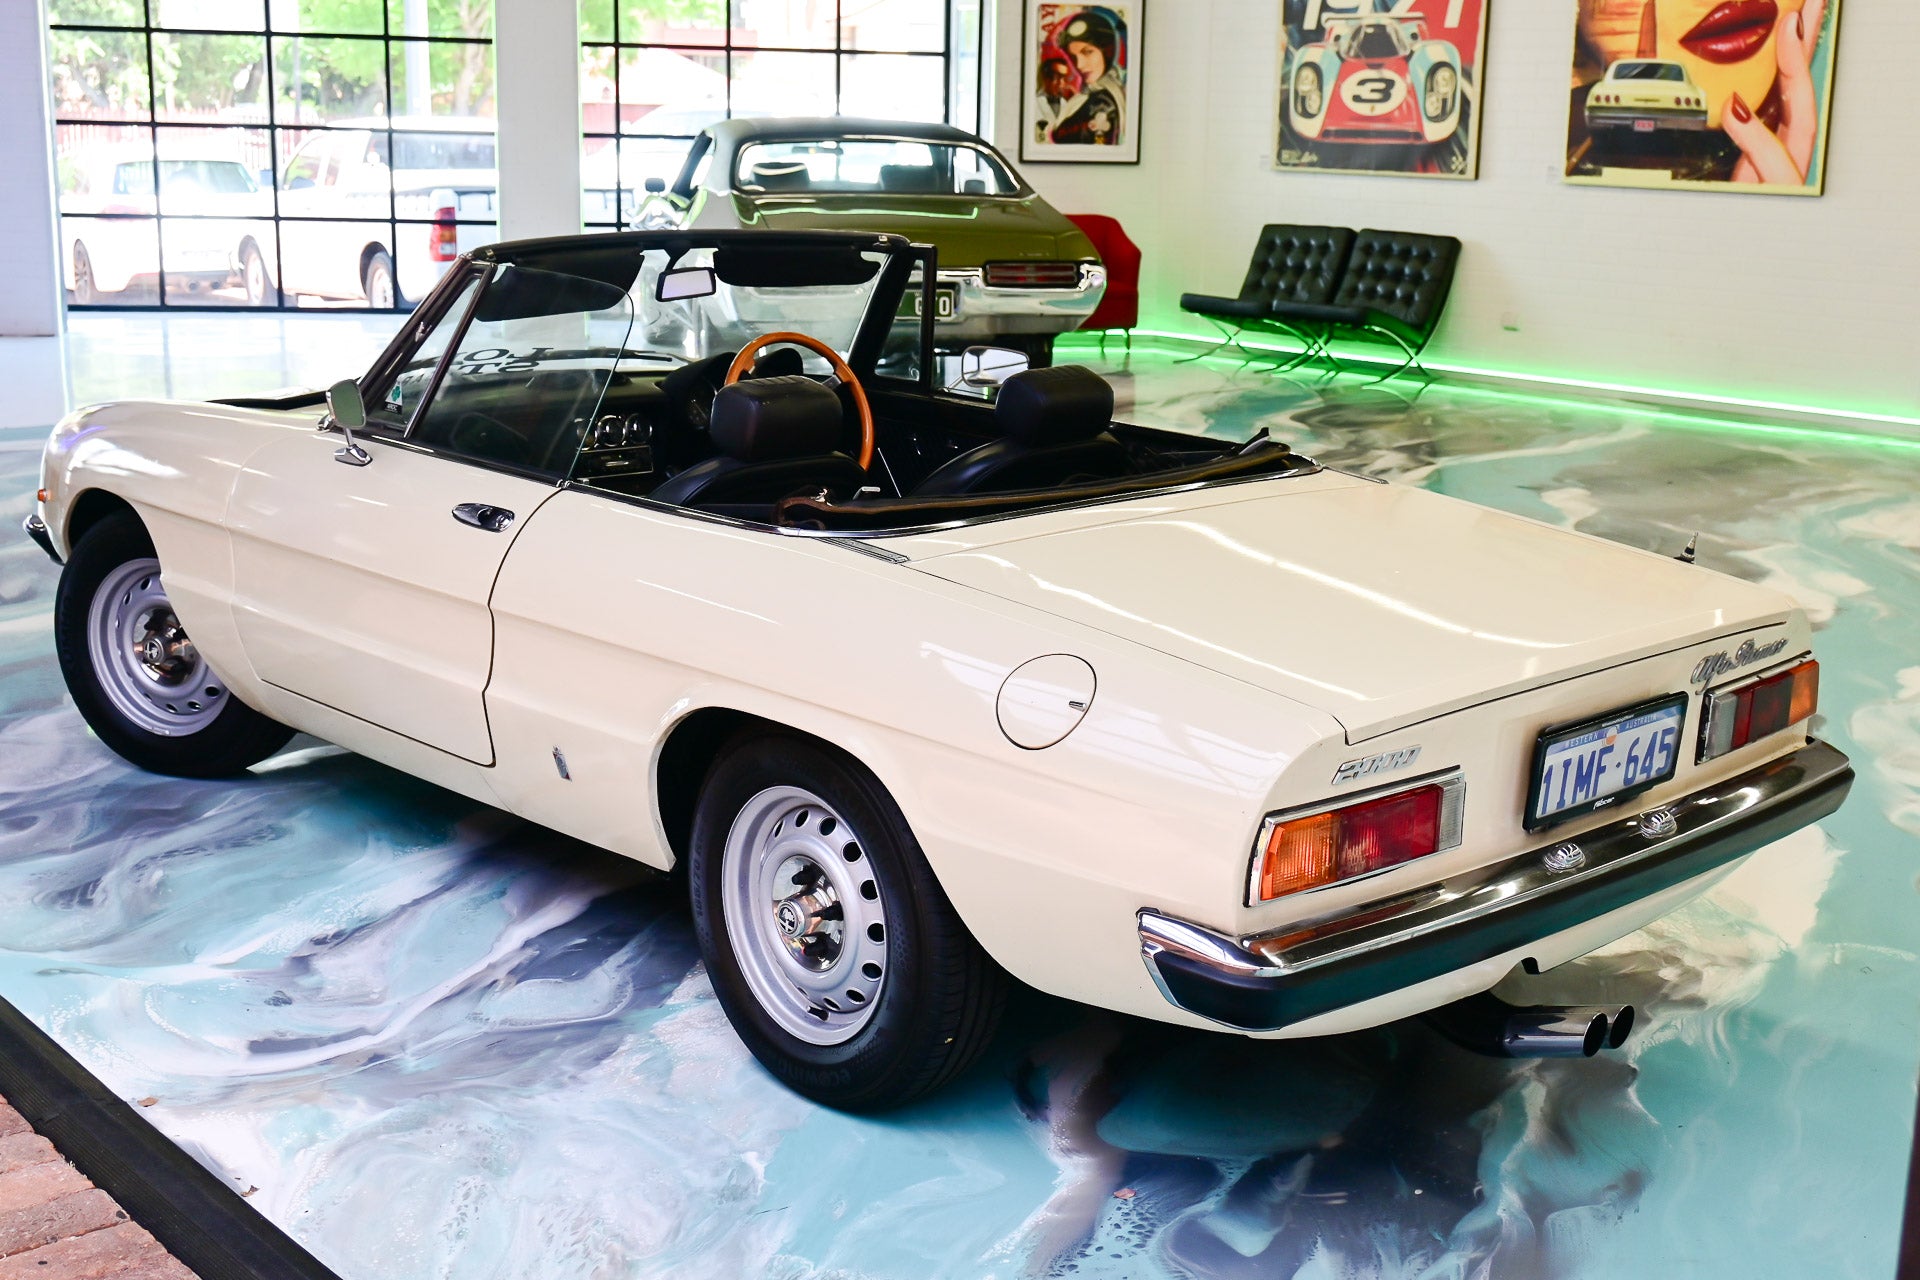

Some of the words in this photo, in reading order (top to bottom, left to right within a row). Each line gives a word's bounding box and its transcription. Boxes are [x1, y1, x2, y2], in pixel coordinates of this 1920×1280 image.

[1352, 78, 1396, 104] 3
[914, 296, 950, 316] GO
[1563, 732, 1598, 748] ESTERN
[1625, 714, 1657, 729] AUSTRALIA
[1331, 745, 1422, 785] 2000
